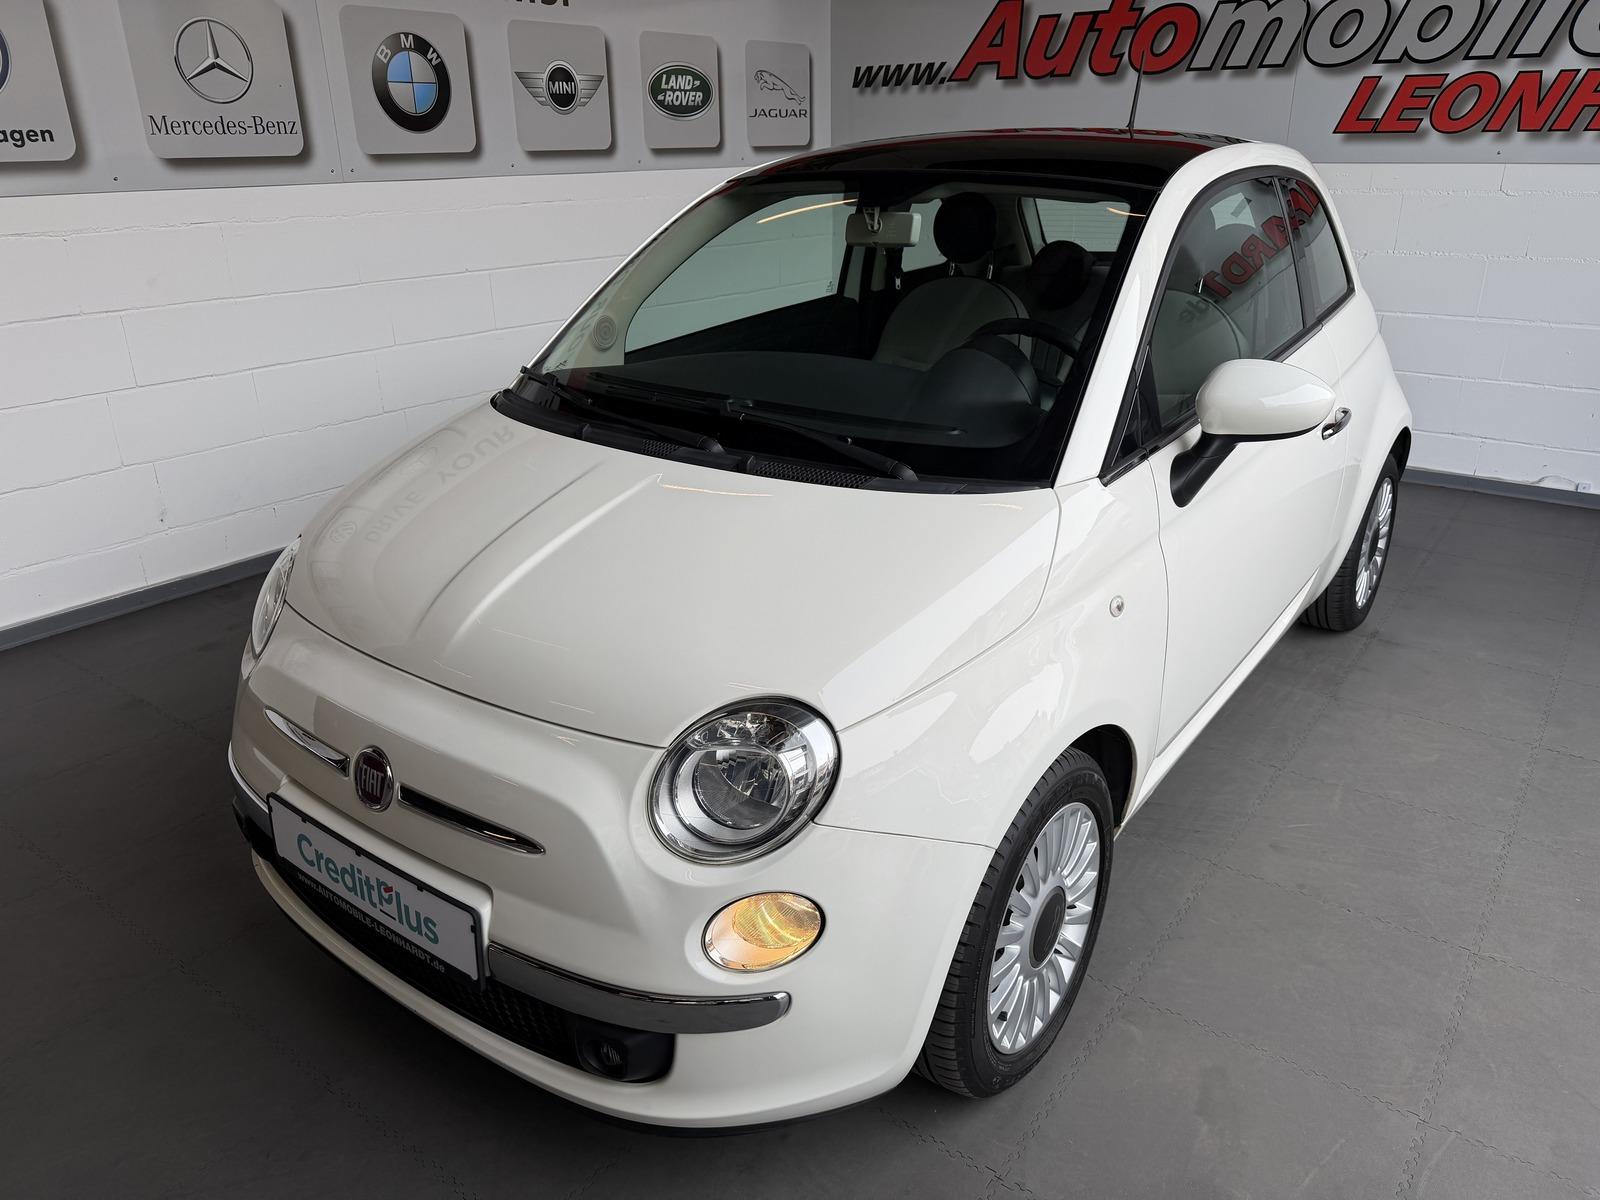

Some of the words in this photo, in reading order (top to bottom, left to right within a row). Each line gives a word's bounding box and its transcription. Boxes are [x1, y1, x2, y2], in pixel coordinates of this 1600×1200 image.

[376, 33, 441, 66] BMW
[549, 80, 576, 95] MINI
[661, 73, 694, 90] LAND
[665, 91, 703, 107] ROVER
[749, 107, 808, 119] JAGUAR
[148, 114, 299, 137] Mercedes-Benz
[361, 764, 385, 799] FIAT
